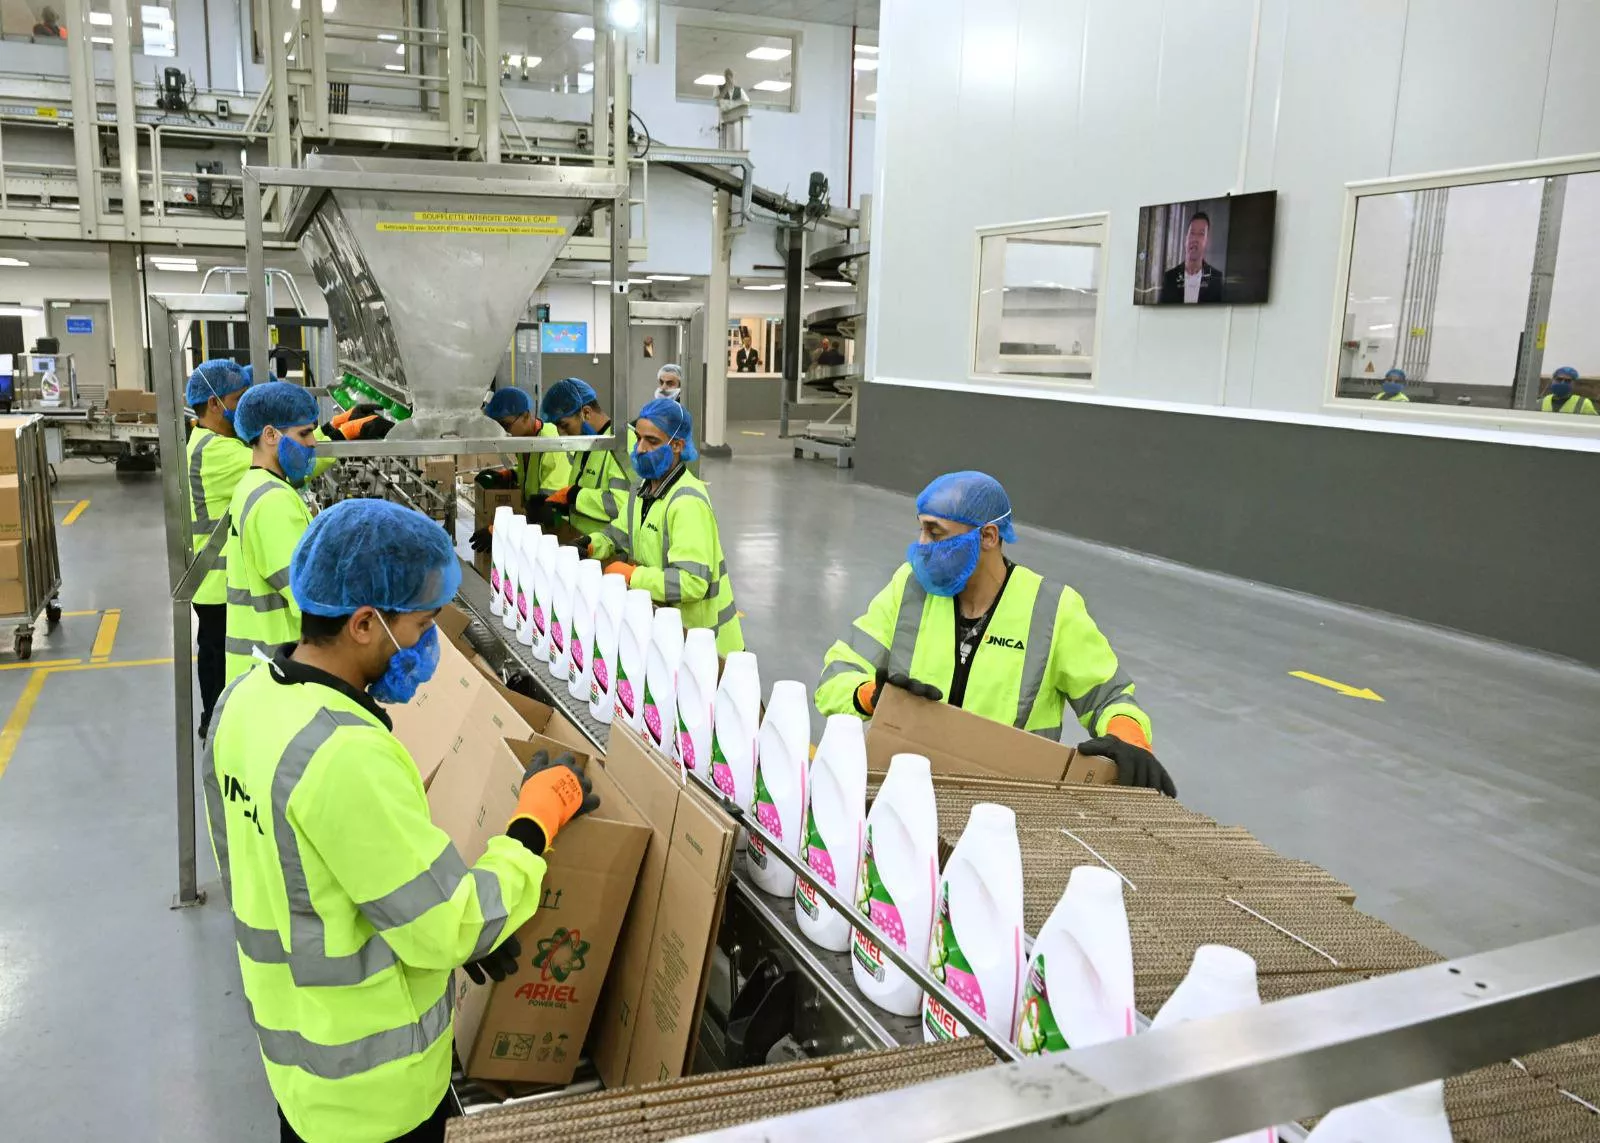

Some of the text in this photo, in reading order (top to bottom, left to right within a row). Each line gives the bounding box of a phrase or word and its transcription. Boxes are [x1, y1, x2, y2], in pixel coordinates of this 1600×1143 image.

[422, 213, 464, 221] SOUFFLETTE
[467, 214, 500, 222] INTERDITE
[514, 983, 579, 1003] ARIEL
[527, 999, 553, 1009] POWER
